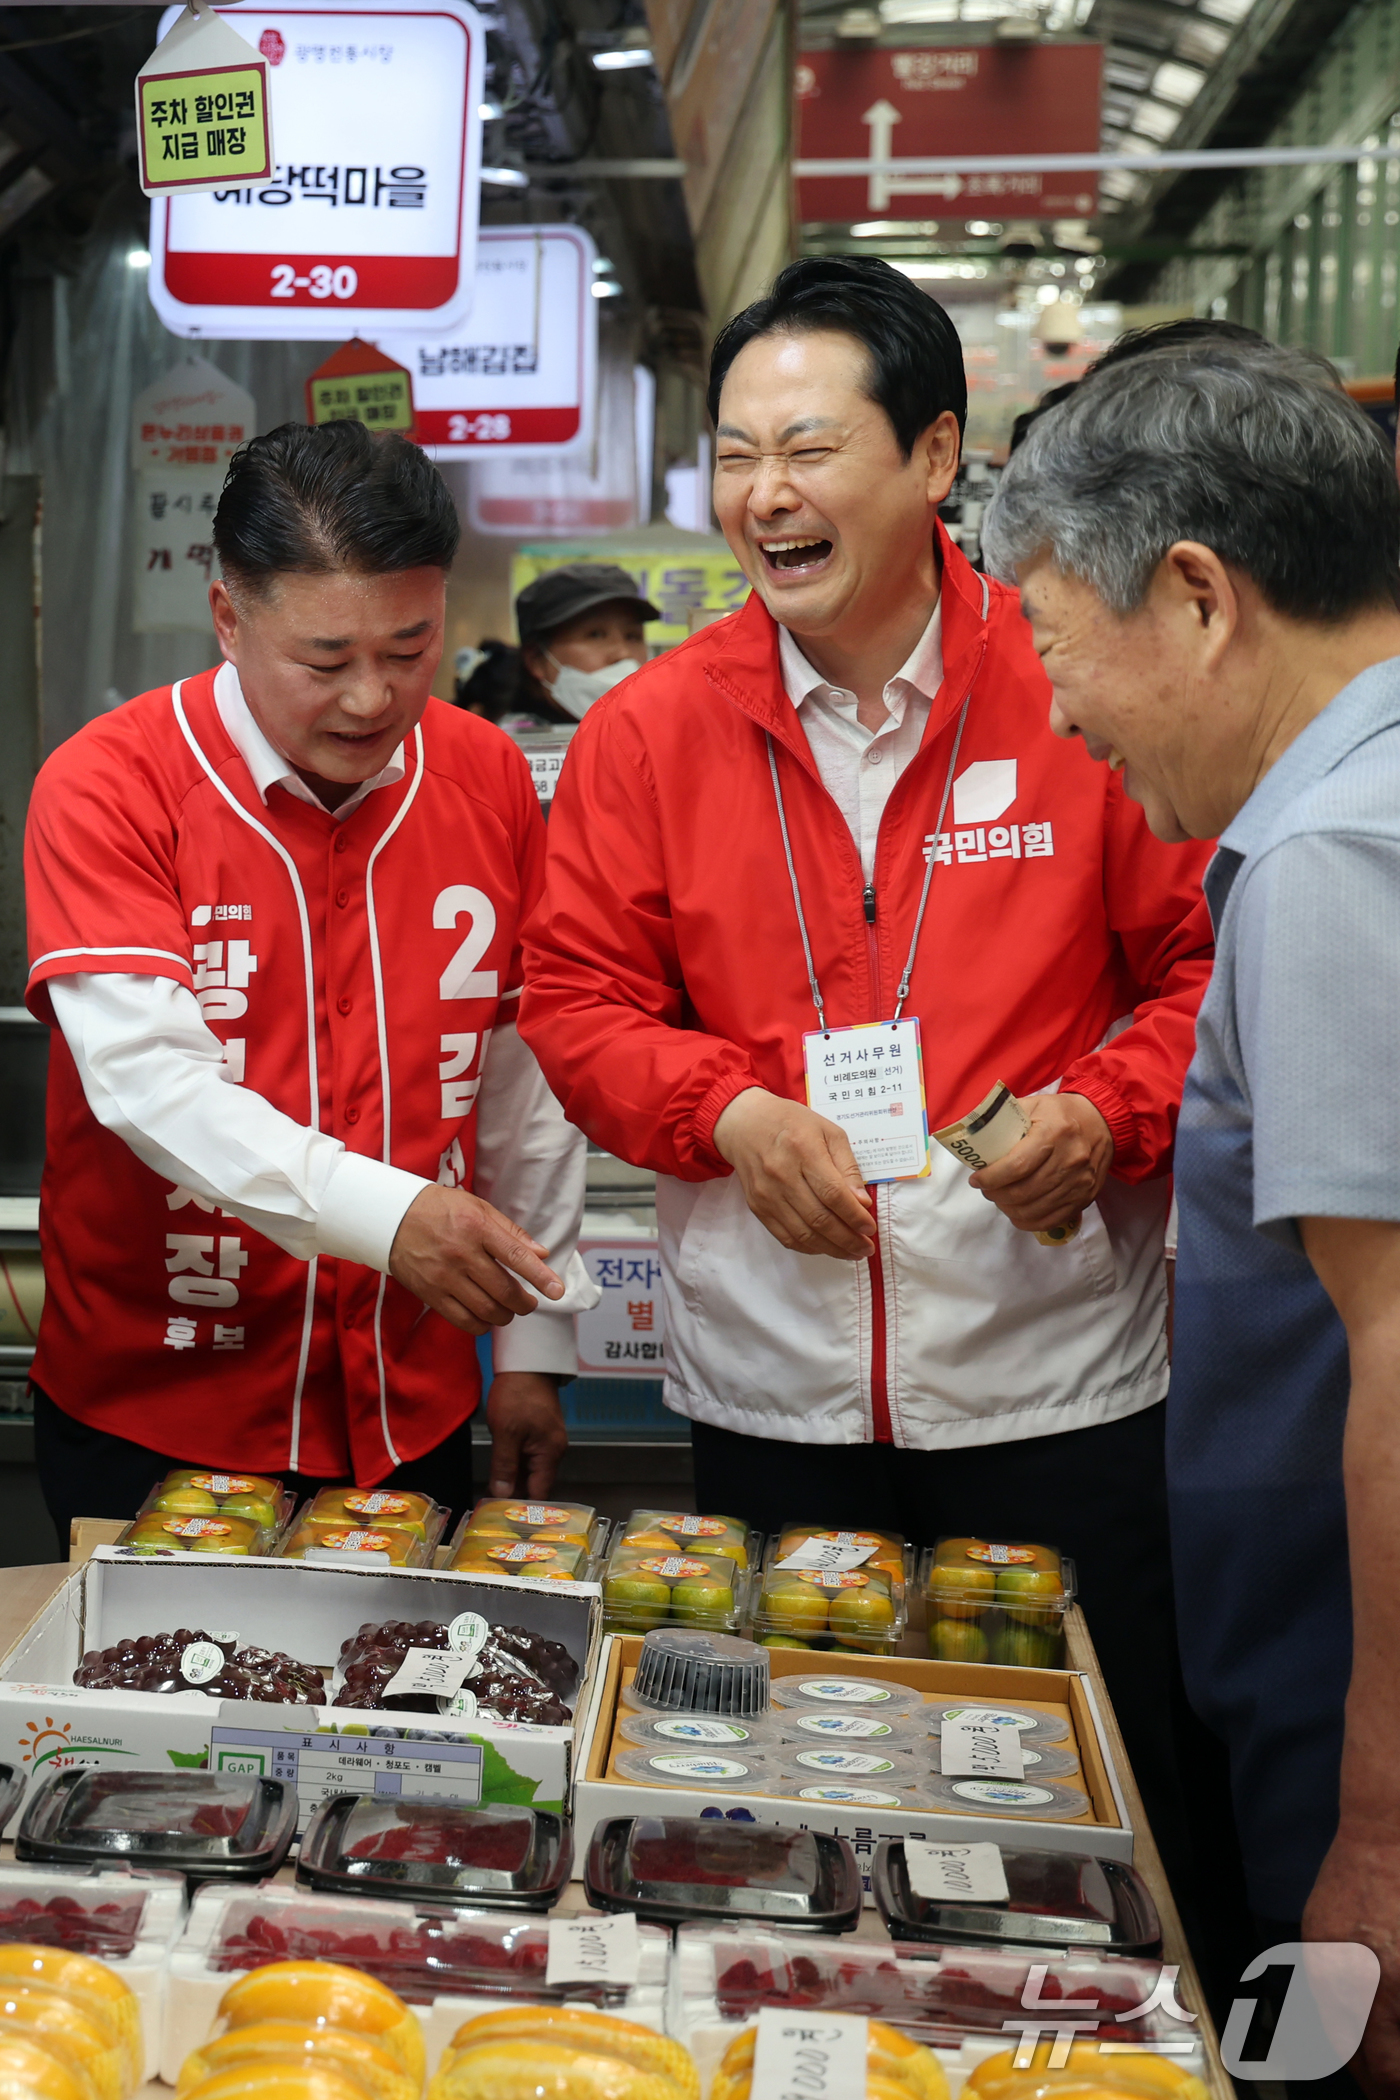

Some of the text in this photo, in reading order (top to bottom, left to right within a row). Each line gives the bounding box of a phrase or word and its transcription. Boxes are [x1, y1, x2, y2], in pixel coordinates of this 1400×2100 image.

[151, 91, 255, 127] 주차 할인권
[162, 127, 246, 160] 지급 매장
[270, 264, 358, 299] 2-30
[922, 821, 1054, 865] 국민의힘
[212, 904, 252, 920] 민의힘
[432, 885, 498, 1001] 2
[823, 1043, 902, 1067] 선거사무원
[833, 1068, 877, 1083] 비례도의원
[828, 1083, 903, 1102] 국민의힘 2-11
[597, 1258, 662, 1289] 전자
[163, 1316, 245, 1350] 후보
[70, 1735, 123, 1746] HAESALNURI
[277, 1751, 295, 1762] 품목
[338, 1757, 441, 1773] 데라웨어 청포도 캠벨
[228, 1762, 254, 1773] GAP
[276, 1767, 294, 1778] 중량
[326, 1772, 343, 1782] 2kg
